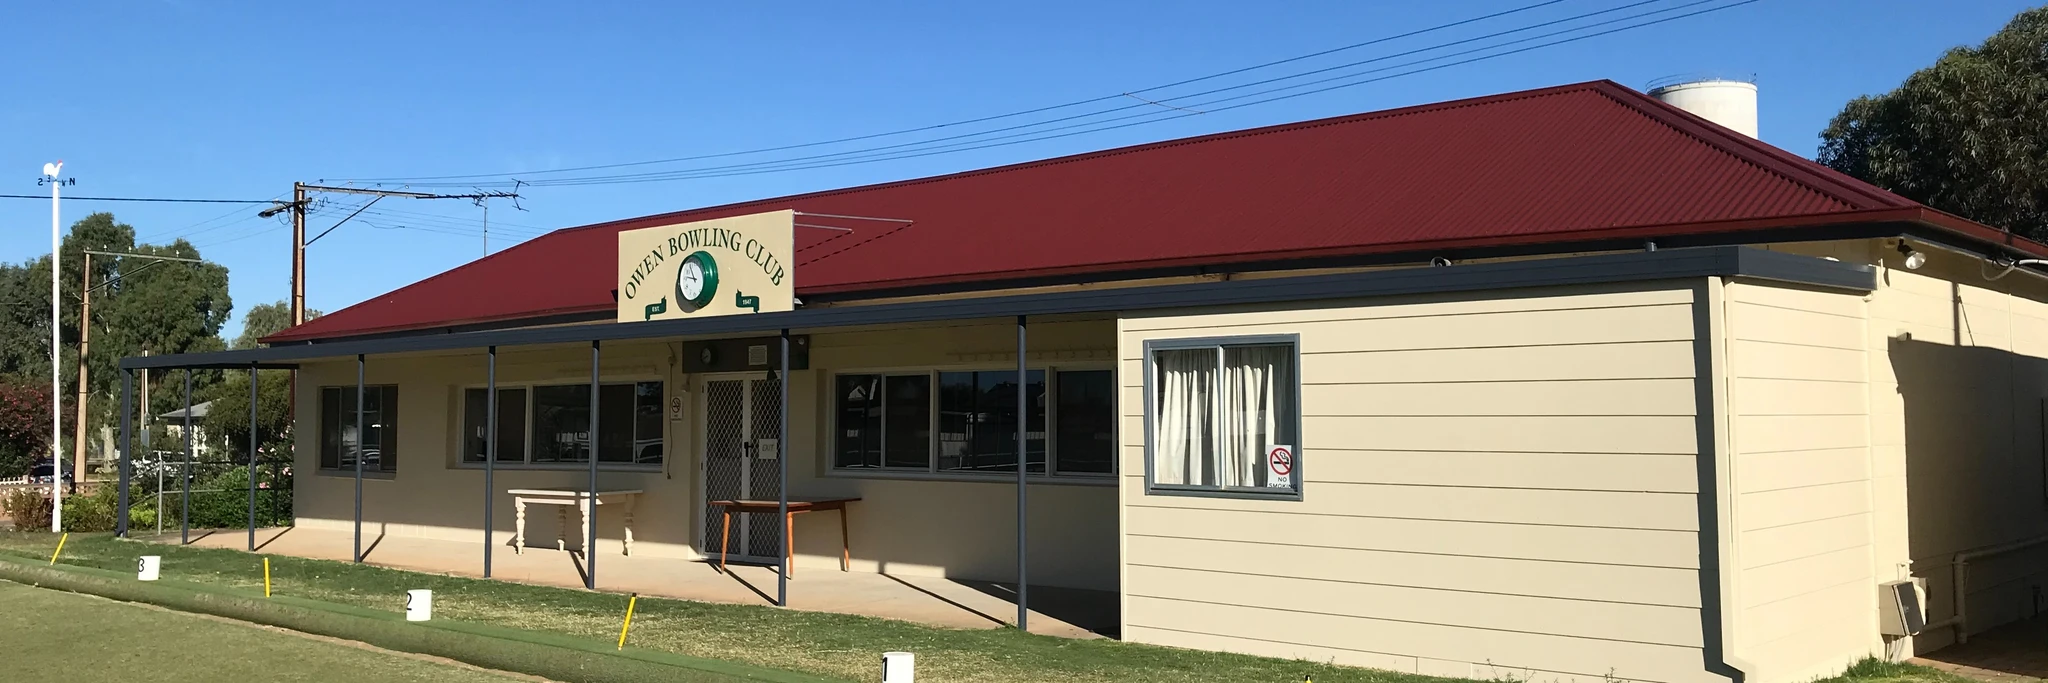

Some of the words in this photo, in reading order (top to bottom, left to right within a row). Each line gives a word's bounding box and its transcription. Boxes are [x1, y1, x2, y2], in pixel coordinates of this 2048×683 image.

[69, 177, 75, 186] N
[625, 244, 664, 300] OWEN
[667, 227, 742, 258] BOWLING
[745, 238, 785, 287] CLUB
[138, 558, 145, 572] 3
[406, 592, 412, 611] 2
[882, 656, 888, 682] 1
